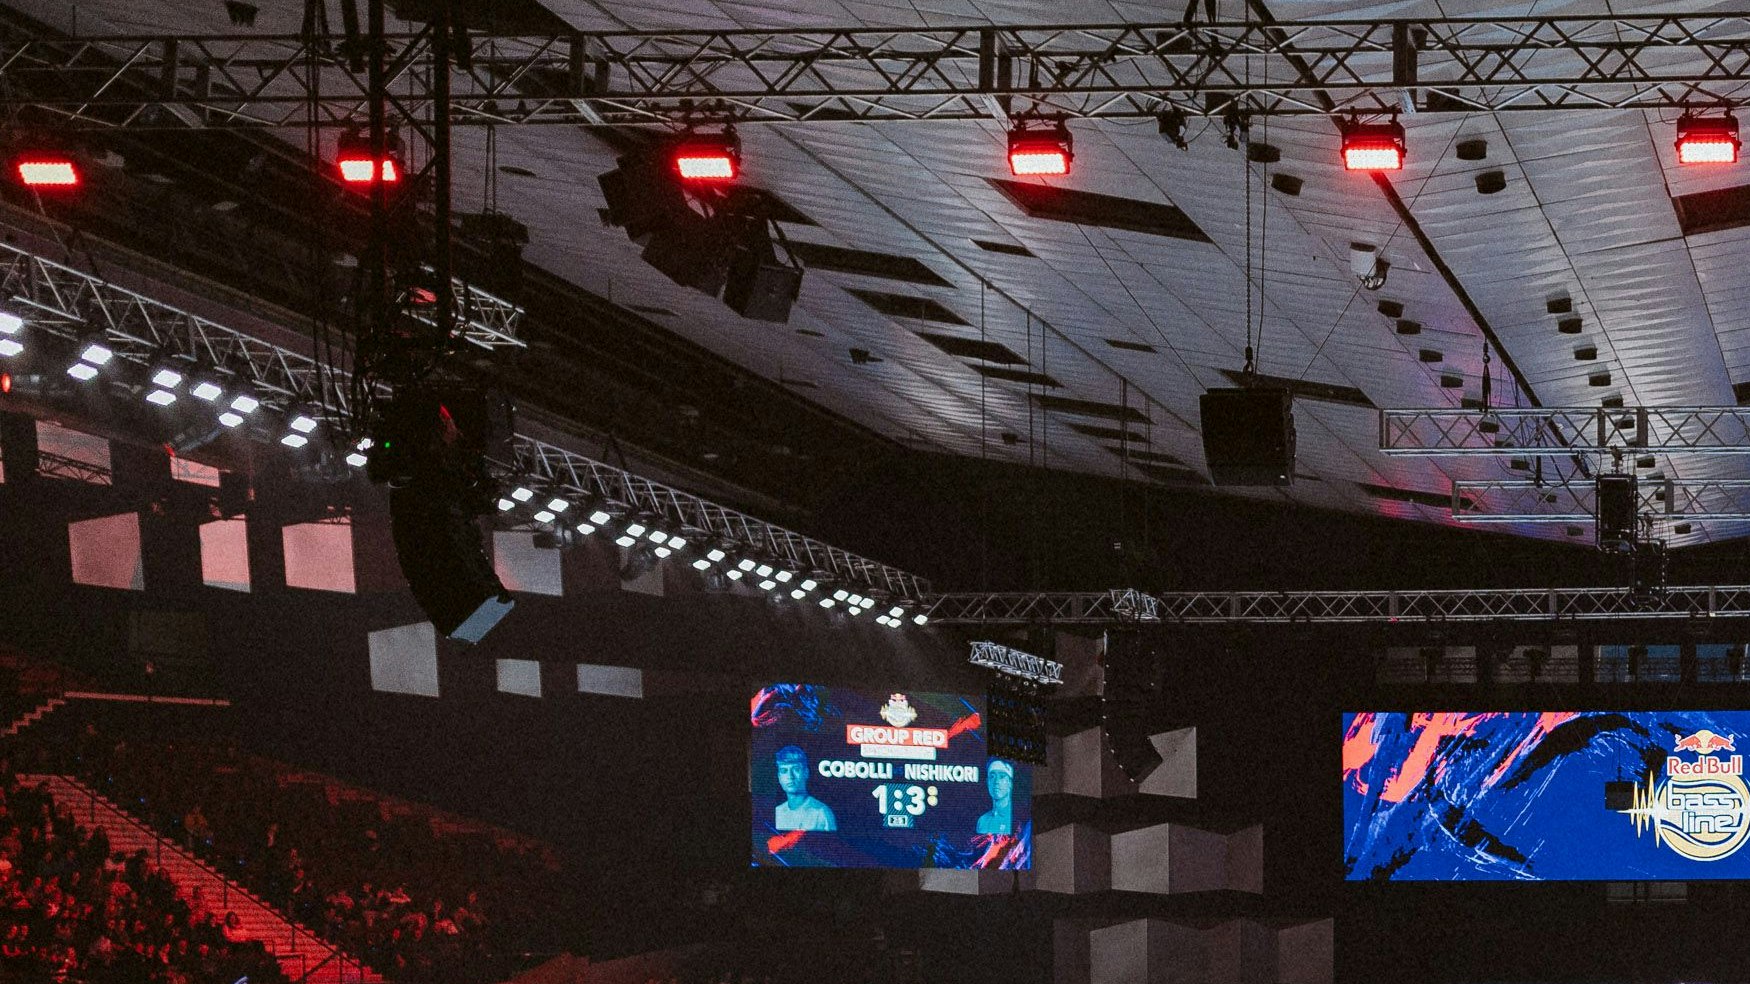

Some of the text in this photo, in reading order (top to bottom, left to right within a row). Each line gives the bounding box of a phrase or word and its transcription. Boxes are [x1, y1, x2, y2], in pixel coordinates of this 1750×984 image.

[850, 727, 945, 746] GROUP RED
[818, 760, 979, 783] COBOLLI NISHIKORI
[1667, 755, 1742, 775] Red Bull
